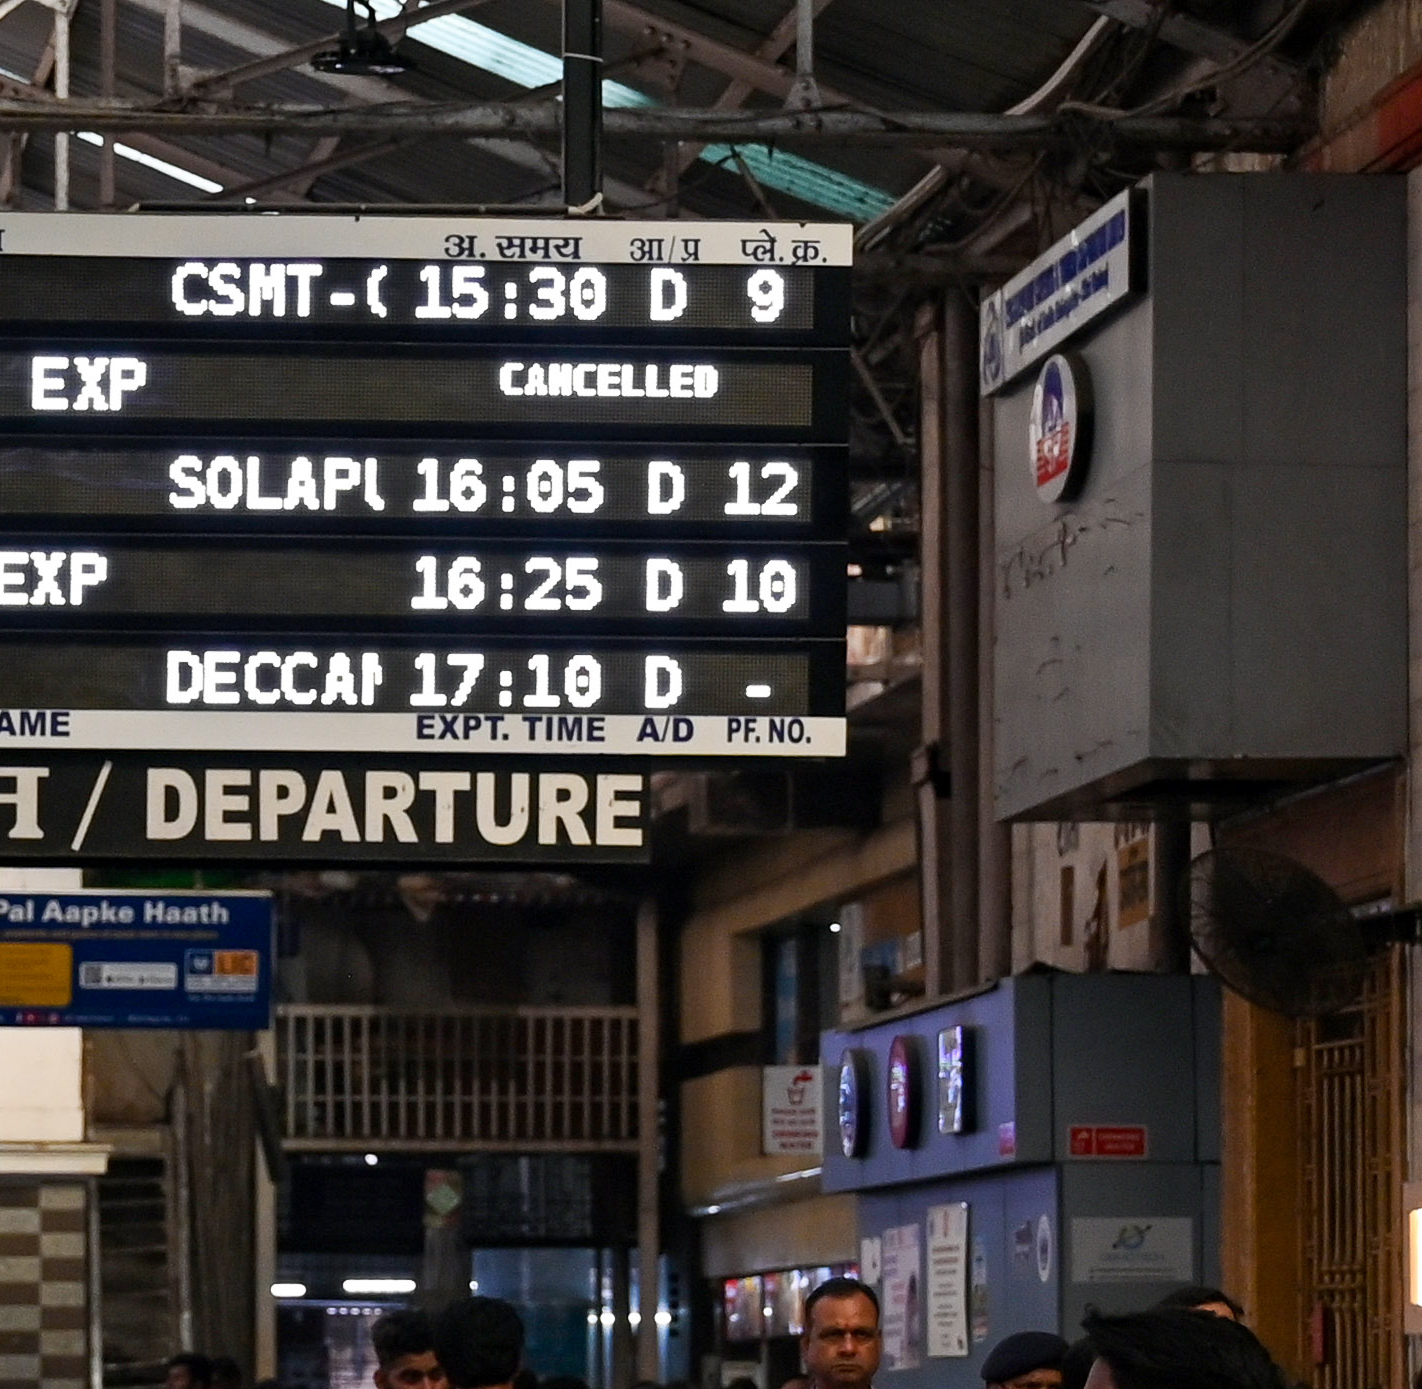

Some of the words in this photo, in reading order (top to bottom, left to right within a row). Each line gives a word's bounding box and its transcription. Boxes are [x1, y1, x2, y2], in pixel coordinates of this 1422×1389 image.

[495, 236, 584, 260] समय
[416, 266, 606, 320] 15:30
[650, 268, 687, 320] D
[748, 270, 784, 322] 9
[32, 357, 146, 410] EXP
[500, 363, 718, 397] CANCELLED
[413, 459, 603, 513] 16:05
[648, 461, 684, 514] D
[725, 462, 798, 515] 12
[411, 556, 602, 610] 16:25
[646, 559, 683, 611] D
[723, 560, 796, 612] 10
[410, 653, 601, 707] 17:10
[645, 656, 682, 708] D
[415, 715, 510, 743] EXPT.
[525, 716, 606, 743] TIME
[637, 716, 695, 743] A/D
[767, 718, 812, 744] NO.
[144, 766, 644, 847] DEPARTURE
[41, 899, 135, 928] Aapke
[143, 901, 230, 925] Haath
